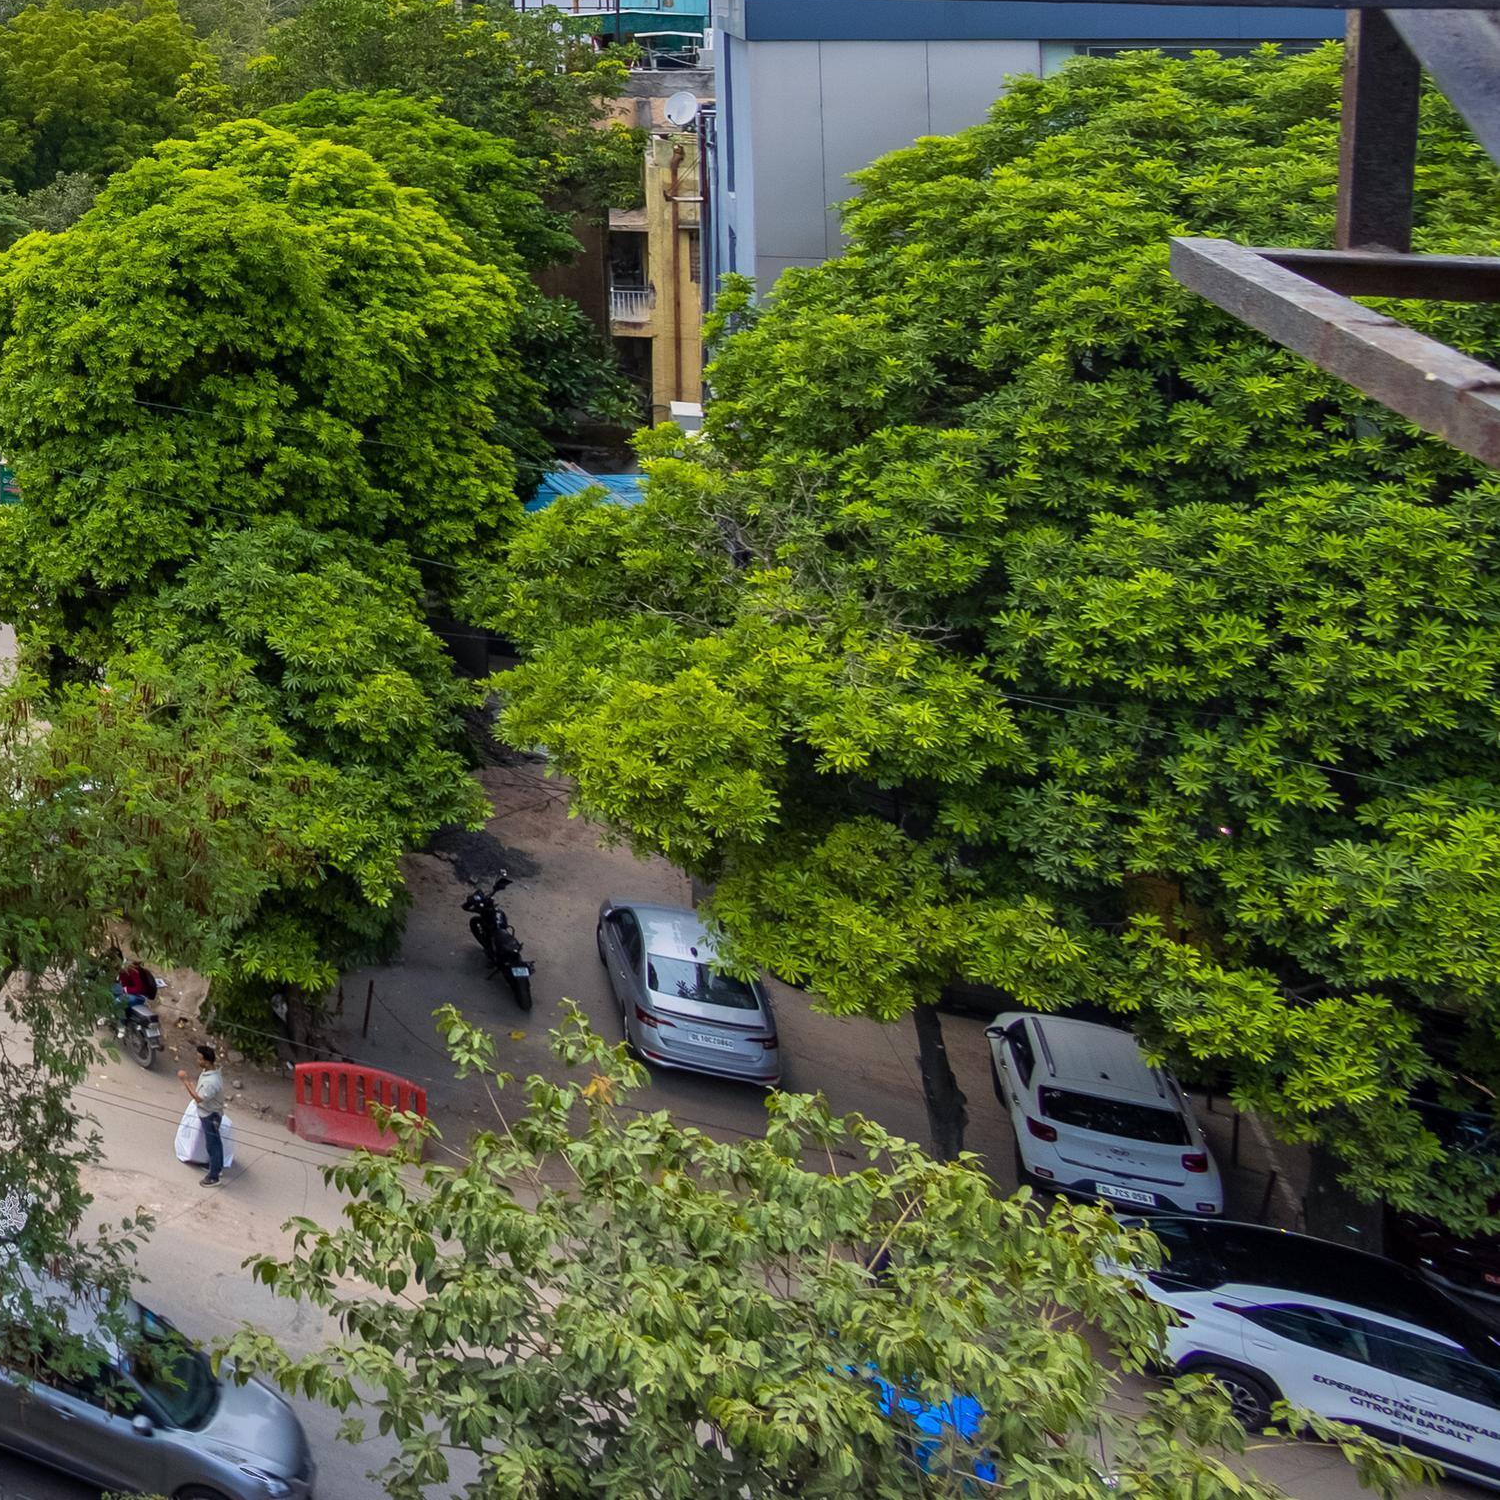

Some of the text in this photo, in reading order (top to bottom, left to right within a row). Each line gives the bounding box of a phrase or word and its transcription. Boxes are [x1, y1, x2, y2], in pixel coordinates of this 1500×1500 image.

[1312, 1374, 1390, 1404] EXPERIENCE
[1392, 1400, 1417, 1414] THE
[1349, 1396, 1414, 1424] CITROËN
[1416, 1417, 1474, 1443] BASALT
